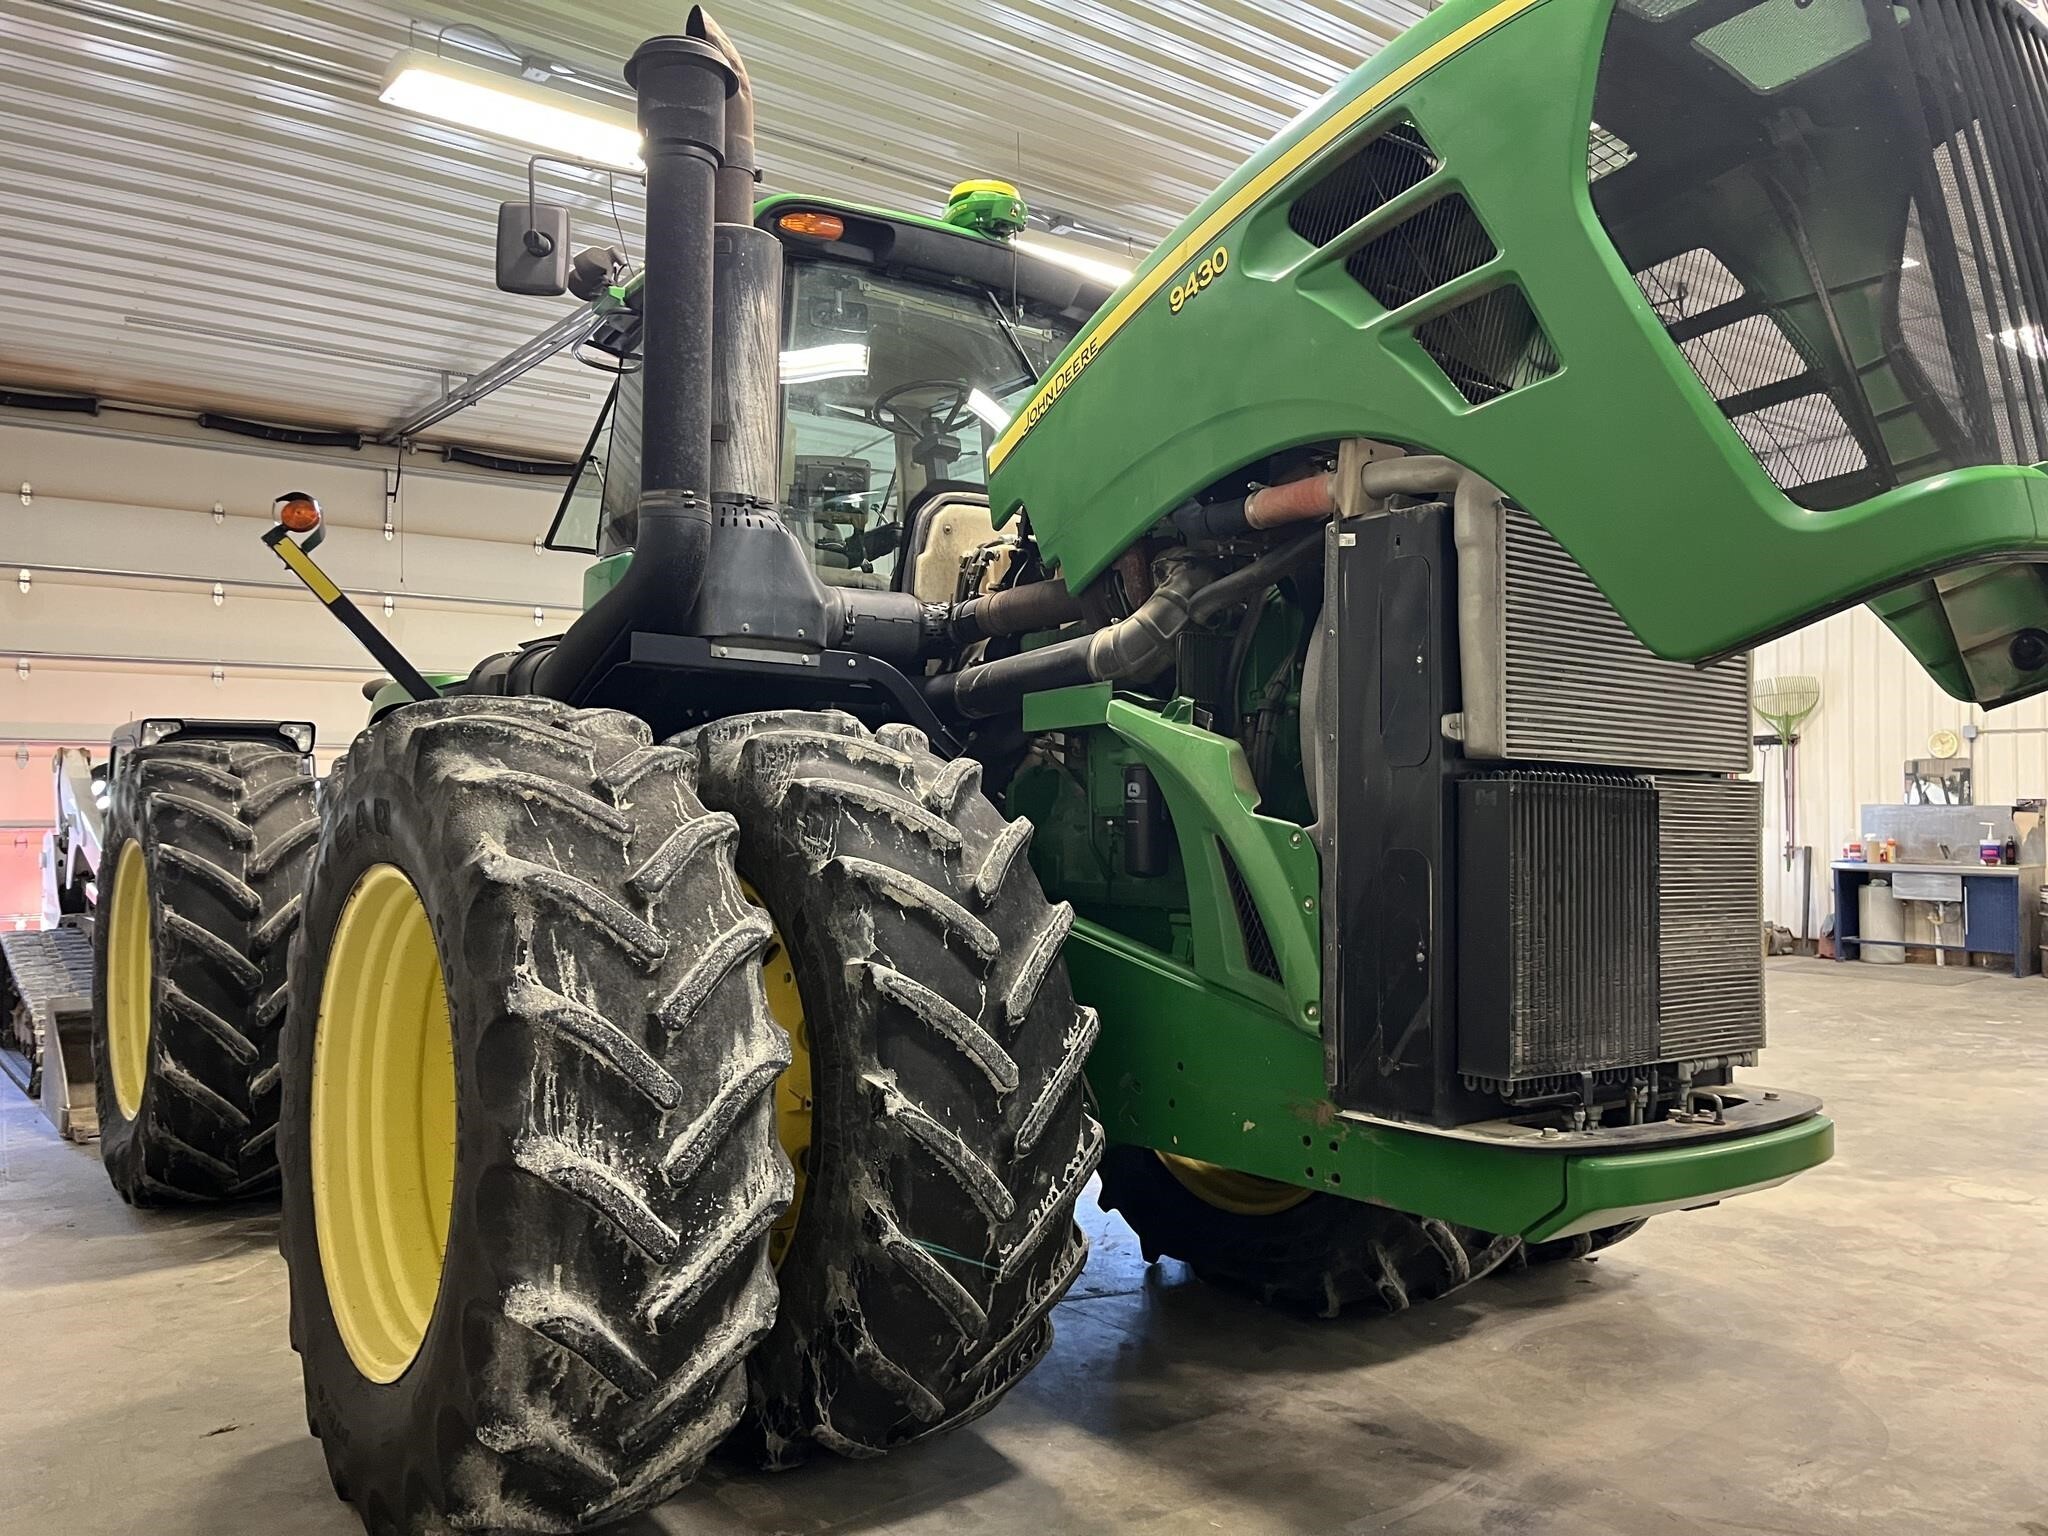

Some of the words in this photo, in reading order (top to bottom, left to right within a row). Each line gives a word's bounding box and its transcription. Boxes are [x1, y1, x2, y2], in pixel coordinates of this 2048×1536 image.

[1168, 246, 1229, 313] 9430
[1024, 387, 1054, 433] JOHN
[1055, 337, 1099, 394] DEERE
